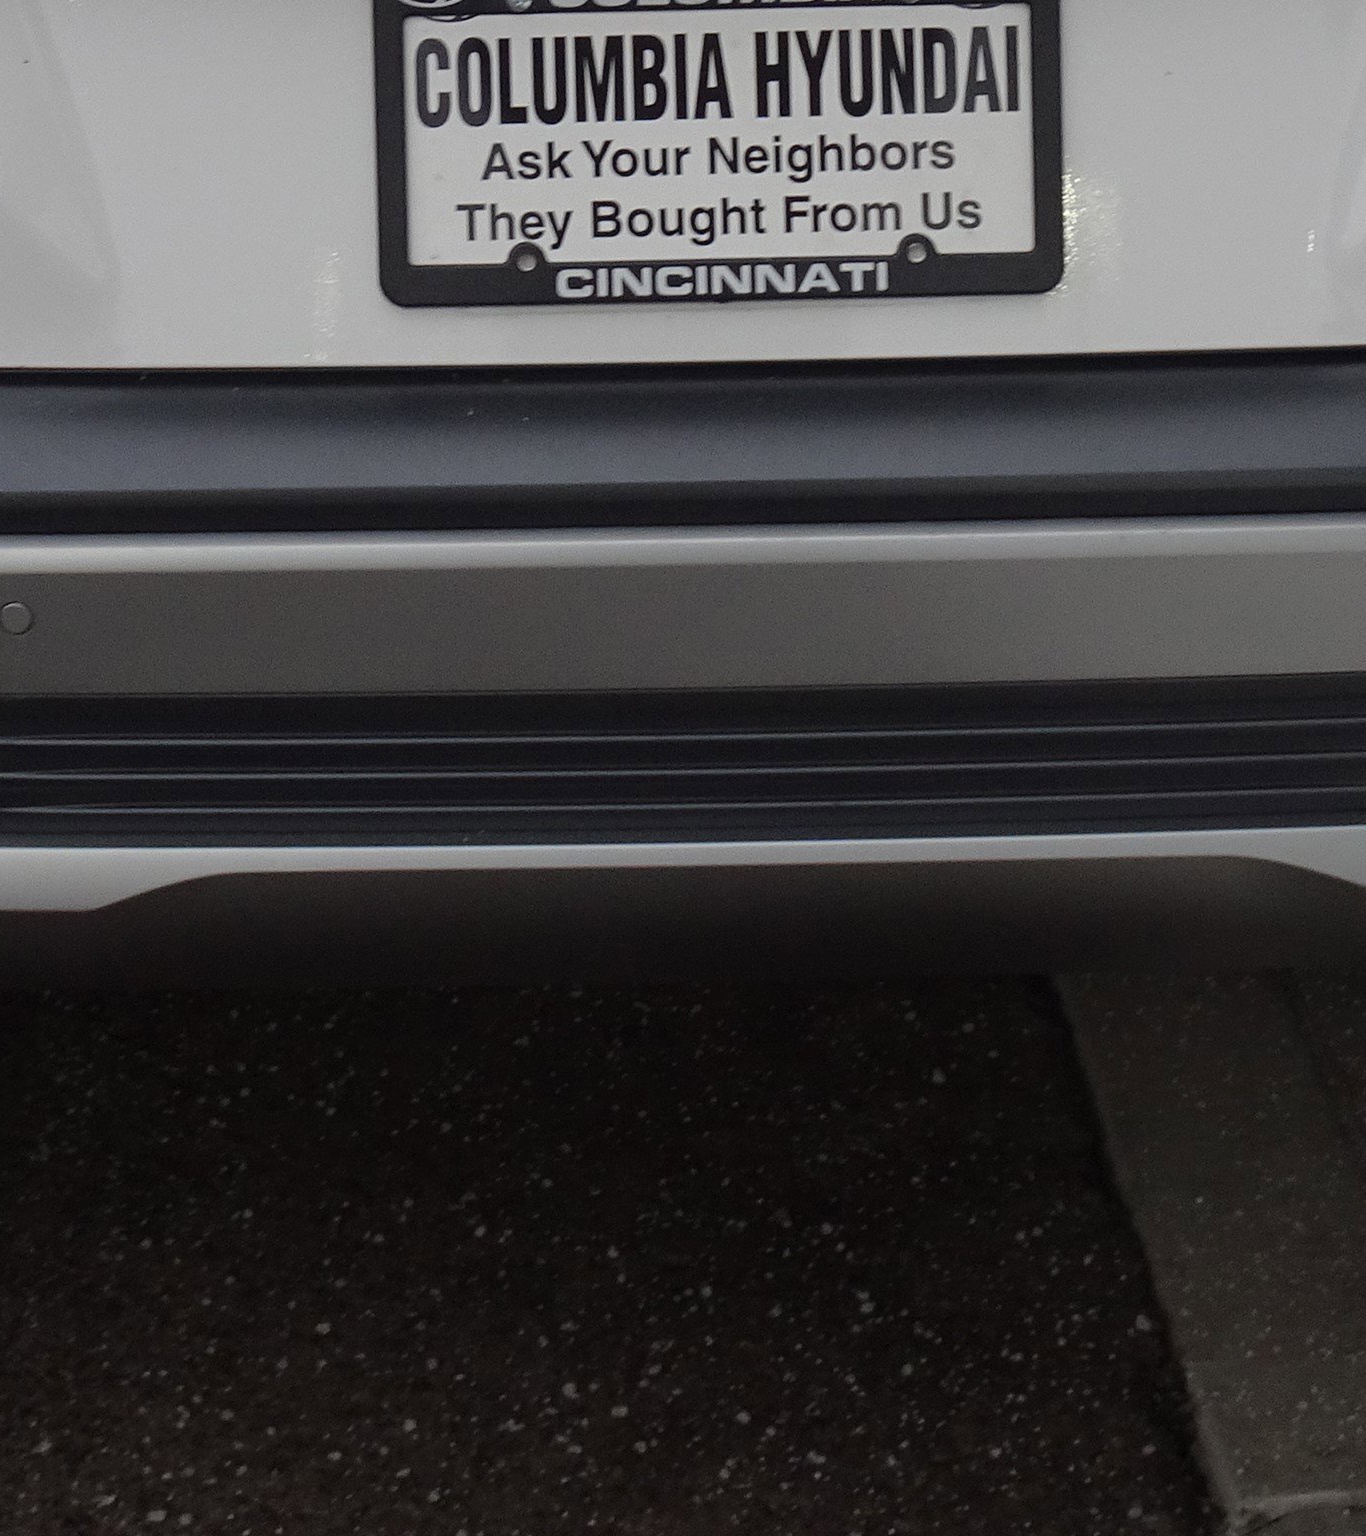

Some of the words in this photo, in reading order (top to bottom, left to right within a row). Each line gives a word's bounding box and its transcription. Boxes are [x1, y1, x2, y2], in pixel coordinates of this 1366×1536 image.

[414, 32, 733, 129] COLUMBIA
[755, 24, 1022, 119] HYUNDAI
[481, 141, 572, 182] Ask
[581, 138, 690, 179] Your
[707, 133, 957, 184] Neighbors
[456, 202, 573, 251] They
[591, 194, 766, 246] Bought
[783, 193, 902, 234] From
[920, 191, 982, 230] Us
[554, 260, 890, 299] CINCINNATI
